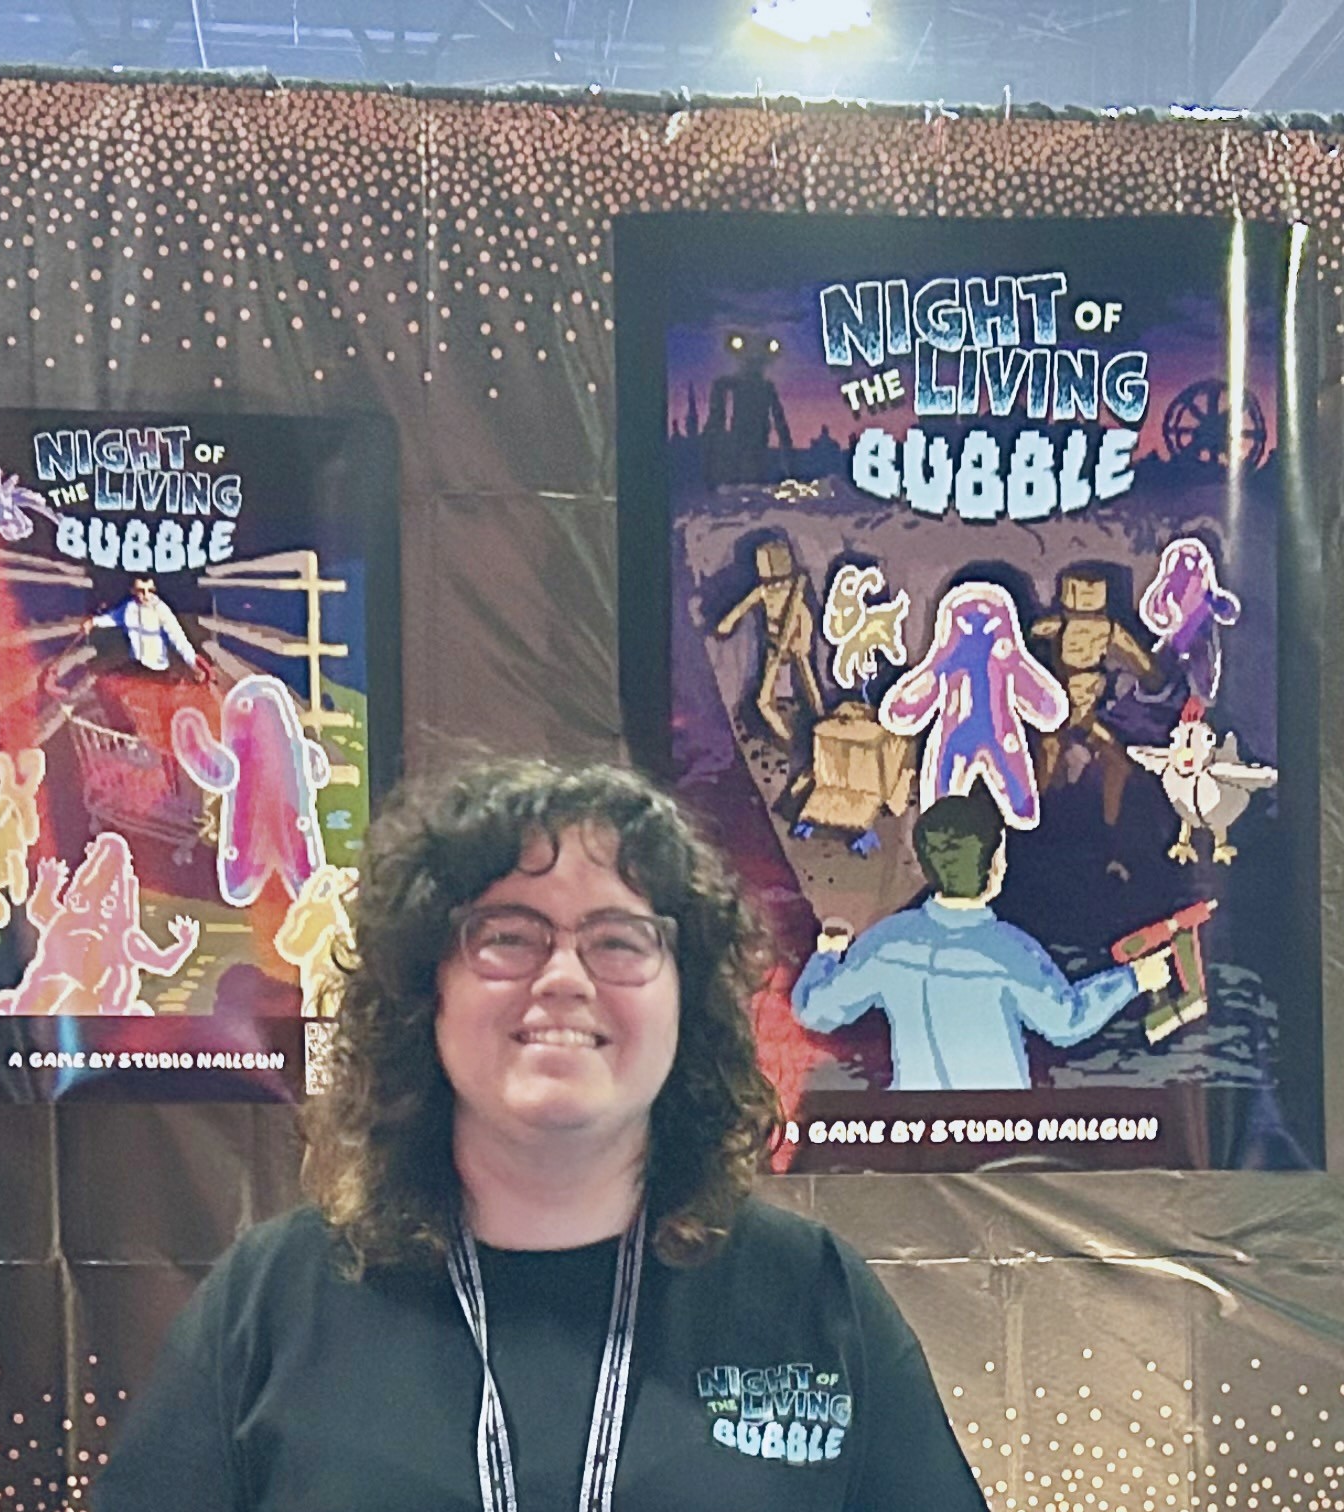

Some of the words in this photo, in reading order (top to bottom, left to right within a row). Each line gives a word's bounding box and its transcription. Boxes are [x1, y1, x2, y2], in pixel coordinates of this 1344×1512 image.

[819, 273, 1067, 366] NIGHT
[1075, 302, 1122, 334] OF
[843, 369, 904, 412] THE
[913, 343, 1149, 421] LIVING
[34, 425, 191, 482] NIGHT
[194, 443, 225, 463] OF
[853, 425, 1139, 521] BUBBLE
[48, 481, 90, 507] THE
[93, 467, 243, 516] LIVING
[55, 515, 235, 573] BUBBLE
[8, 1052, 23, 1069] A
[29, 1052, 85, 1069] GAME
[89, 1052, 115, 1069] BY
[118, 1052, 194, 1069] STUDIO
[196, 1052, 285, 1069] NAILGUN
[785, 1121, 800, 1143] A
[808, 1121, 886, 1144] GAME
[890, 1120, 926, 1143] BY
[930, 1119, 1033, 1143] STUDIO
[1037, 1117, 1158, 1141] NAILGUN
[697, 1362, 814, 1398] NIGHT
[816, 1373, 840, 1386] OF
[707, 1399, 738, 1414] THE
[740, 1390, 852, 1428] LIVING
[713, 1417, 845, 1462] BUBBLE
